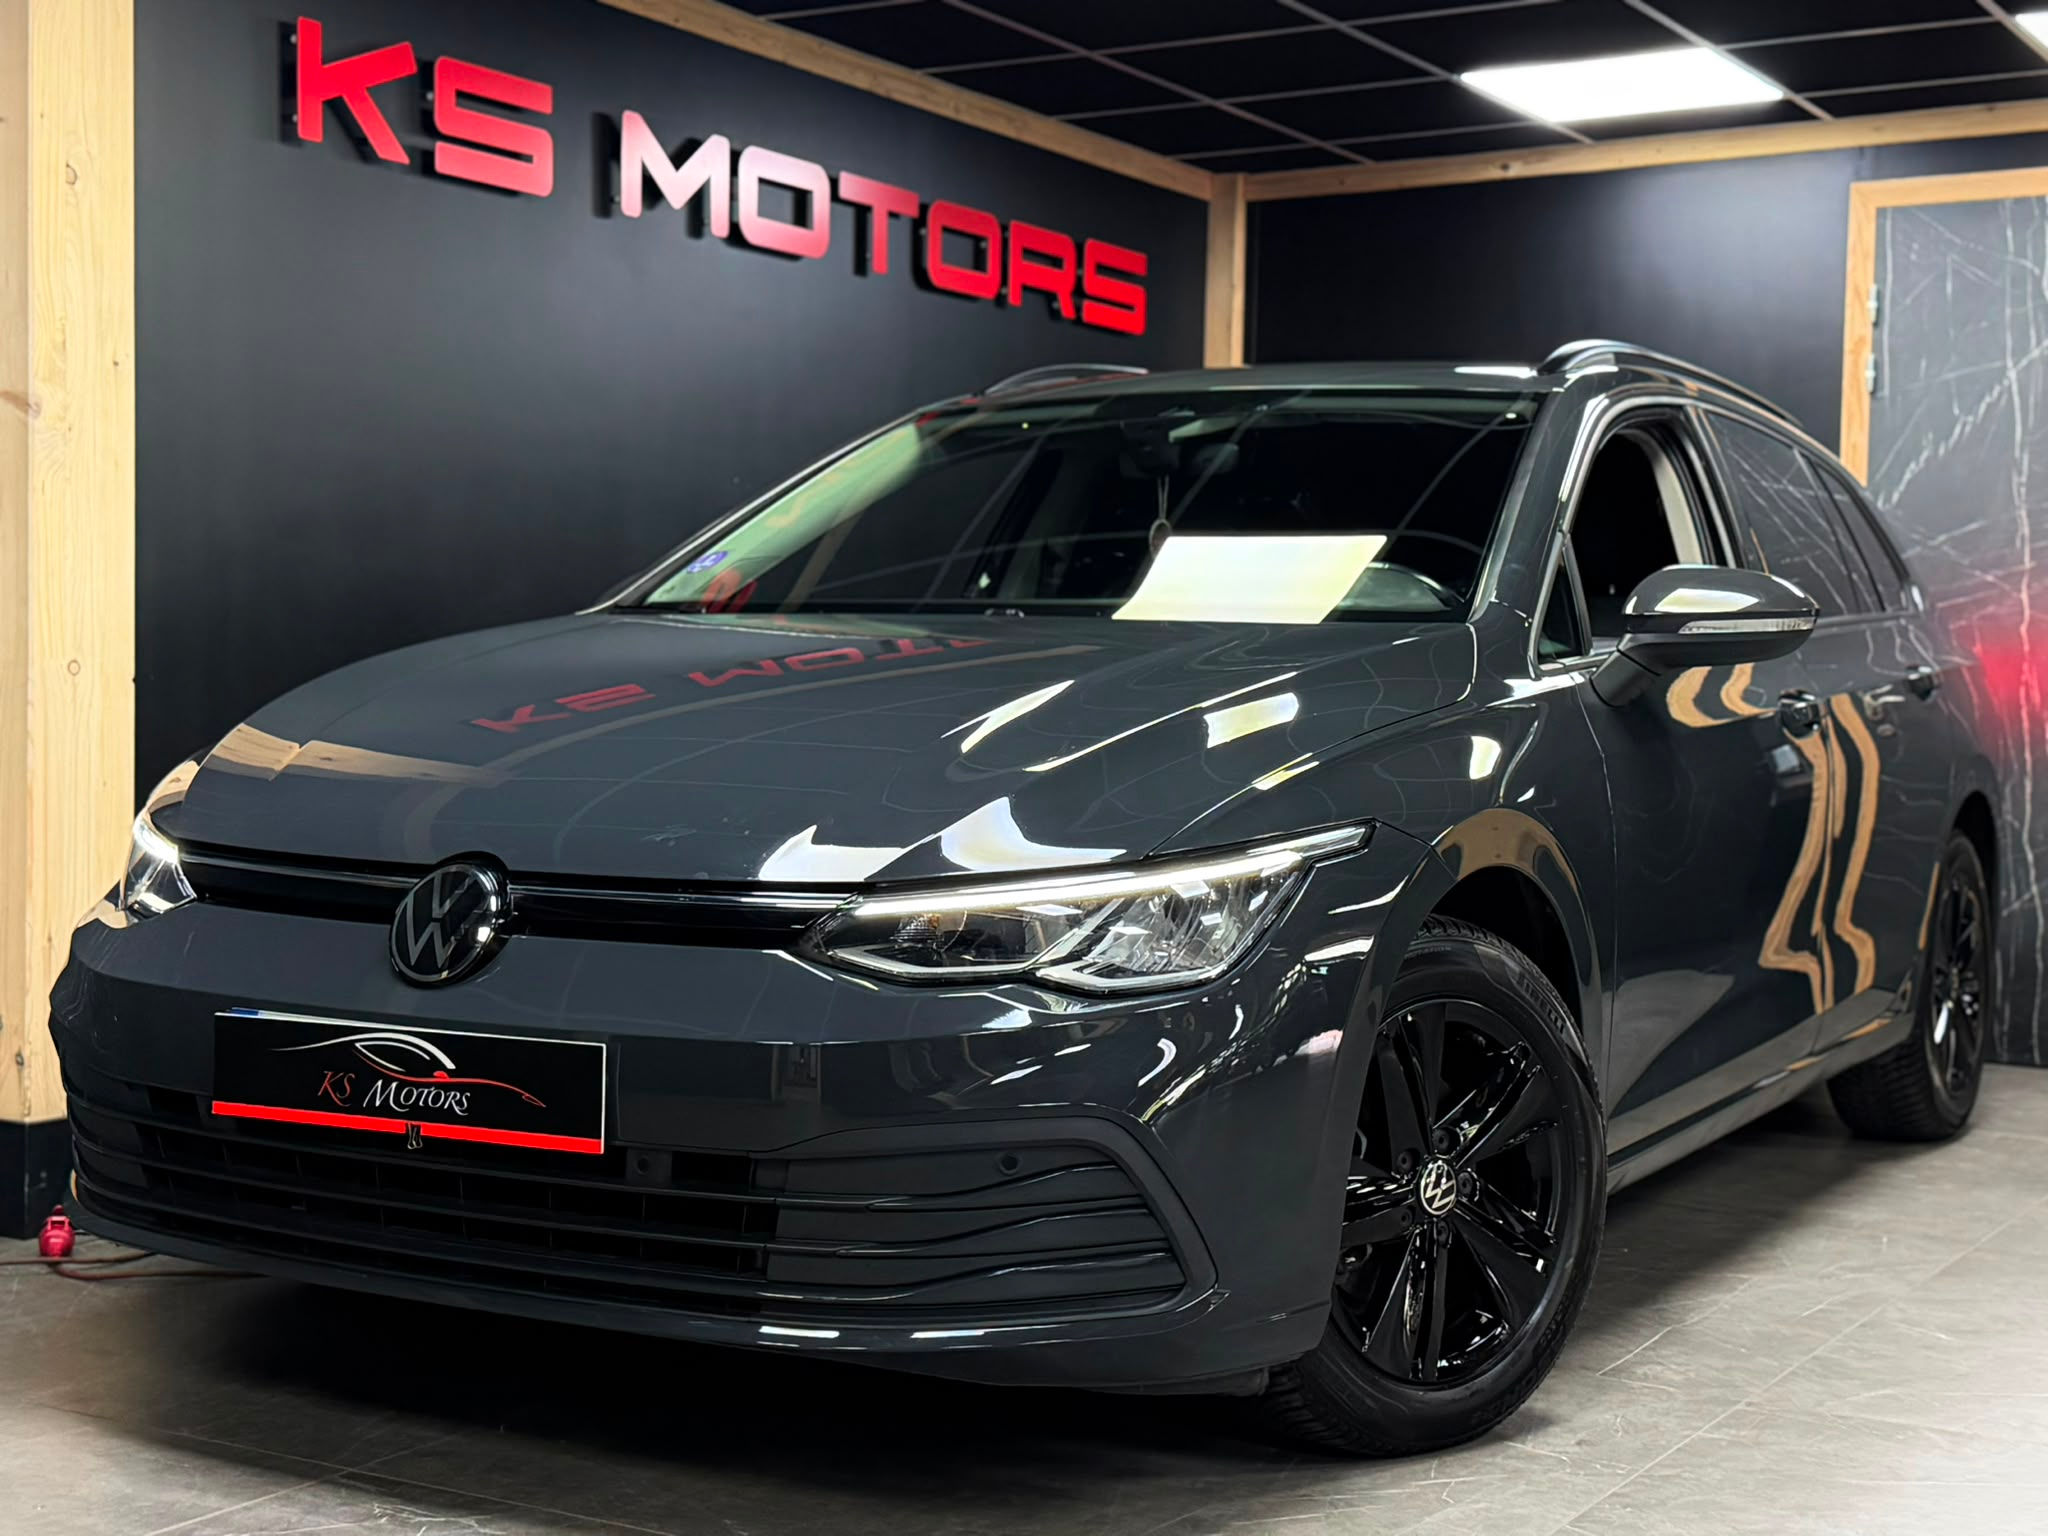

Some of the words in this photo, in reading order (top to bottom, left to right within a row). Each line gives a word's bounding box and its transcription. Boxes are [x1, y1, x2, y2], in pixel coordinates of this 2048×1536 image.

[296, 15, 555, 198] KS
[620, 109, 1148, 336] MOTORS
[317, 1070, 355, 1107] KS
